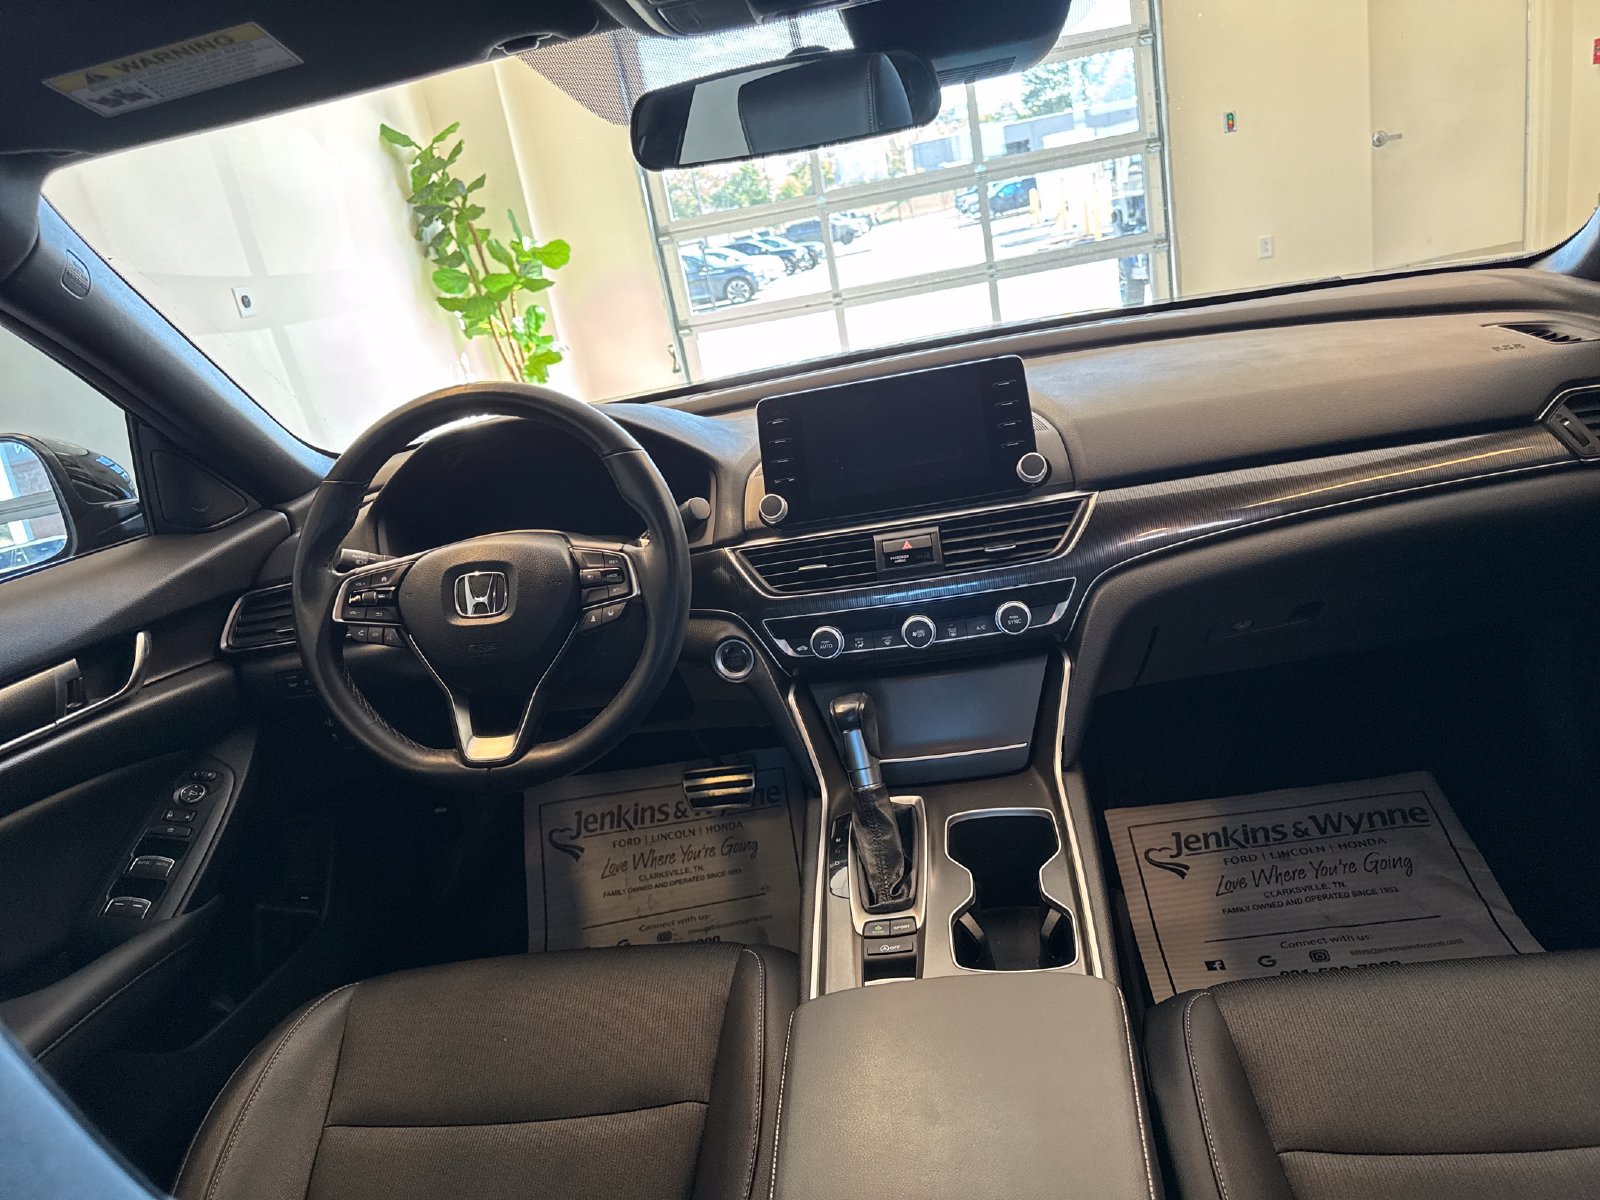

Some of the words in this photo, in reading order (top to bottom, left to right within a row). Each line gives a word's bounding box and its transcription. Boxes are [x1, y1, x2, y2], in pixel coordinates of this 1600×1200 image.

[114, 34, 235, 74] WARNING
[612, 837, 641, 849] FORD
[652, 828, 696, 844] LINCOLN
[706, 821, 744, 834] HONDA
[601, 858, 628, 880] Love
[633, 849, 676, 870] Where
[680, 844, 716, 863] You're
[720, 836, 759, 859] Going
[1223, 853, 1258, 866] FORD
[1270, 845, 1326, 860] LINCOLN
[1338, 836, 1388, 850] HONDA
[603, 887, 627, 898] FAMILY
[628, 884, 653, 894] OWNED
[654, 880, 668, 889] AND
[669, 874, 705, 886] OPERATED
[706, 870, 725, 880] SINCE
[1216, 875, 1248, 897] Love
[1251, 864, 1307, 890] Where
[1309, 859, 1358, 879] You're
[1363, 851, 1414, 877] Going
[1222, 904, 1250, 915] FAMILY
[1252, 901, 1284, 911] OWNED
[1286, 898, 1304, 906] AND
[1305, 891, 1350, 903] OPERATED
[1352, 888, 1378, 898] SINCE
[639, 919, 675, 933] Connect
[677, 915, 697, 926] with
[1280, 937, 1328, 949] Connect
[1329, 933, 1355, 944] with
